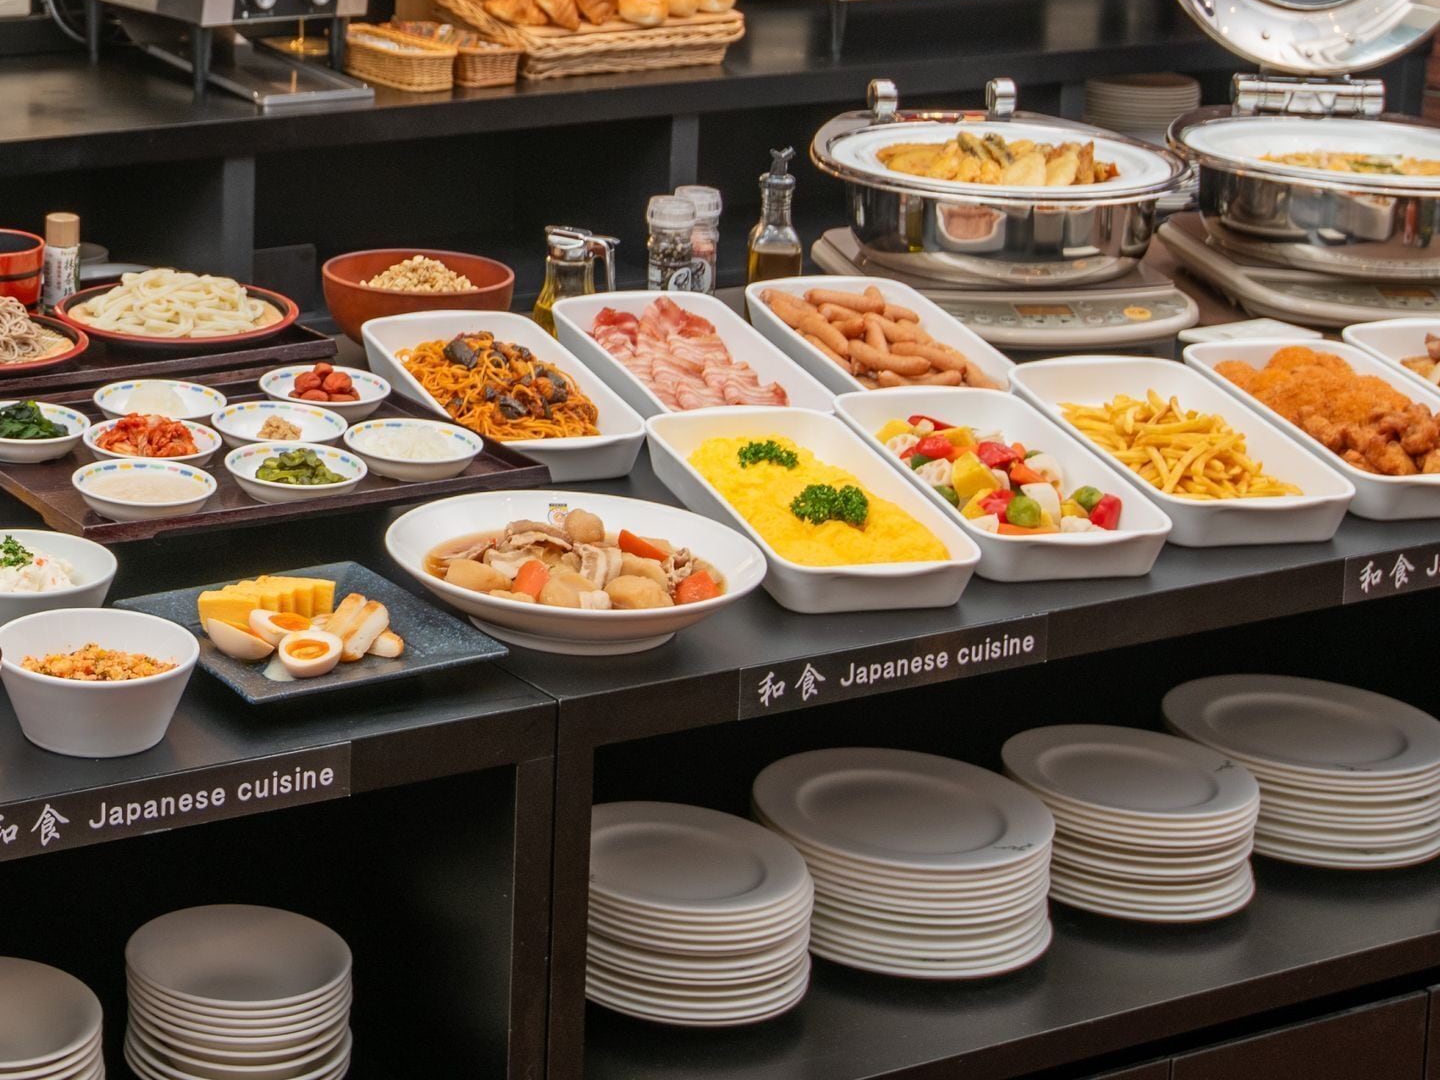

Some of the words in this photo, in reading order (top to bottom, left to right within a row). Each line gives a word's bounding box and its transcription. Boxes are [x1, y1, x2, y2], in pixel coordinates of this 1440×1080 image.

[1359, 553, 1416, 595] 和食
[757, 663, 826, 707] 和食
[839, 650, 949, 688] Japanese
[956, 633, 1035, 666] cuisine
[88, 783, 227, 831] Japanese
[236, 765, 335, 804] cuisine
